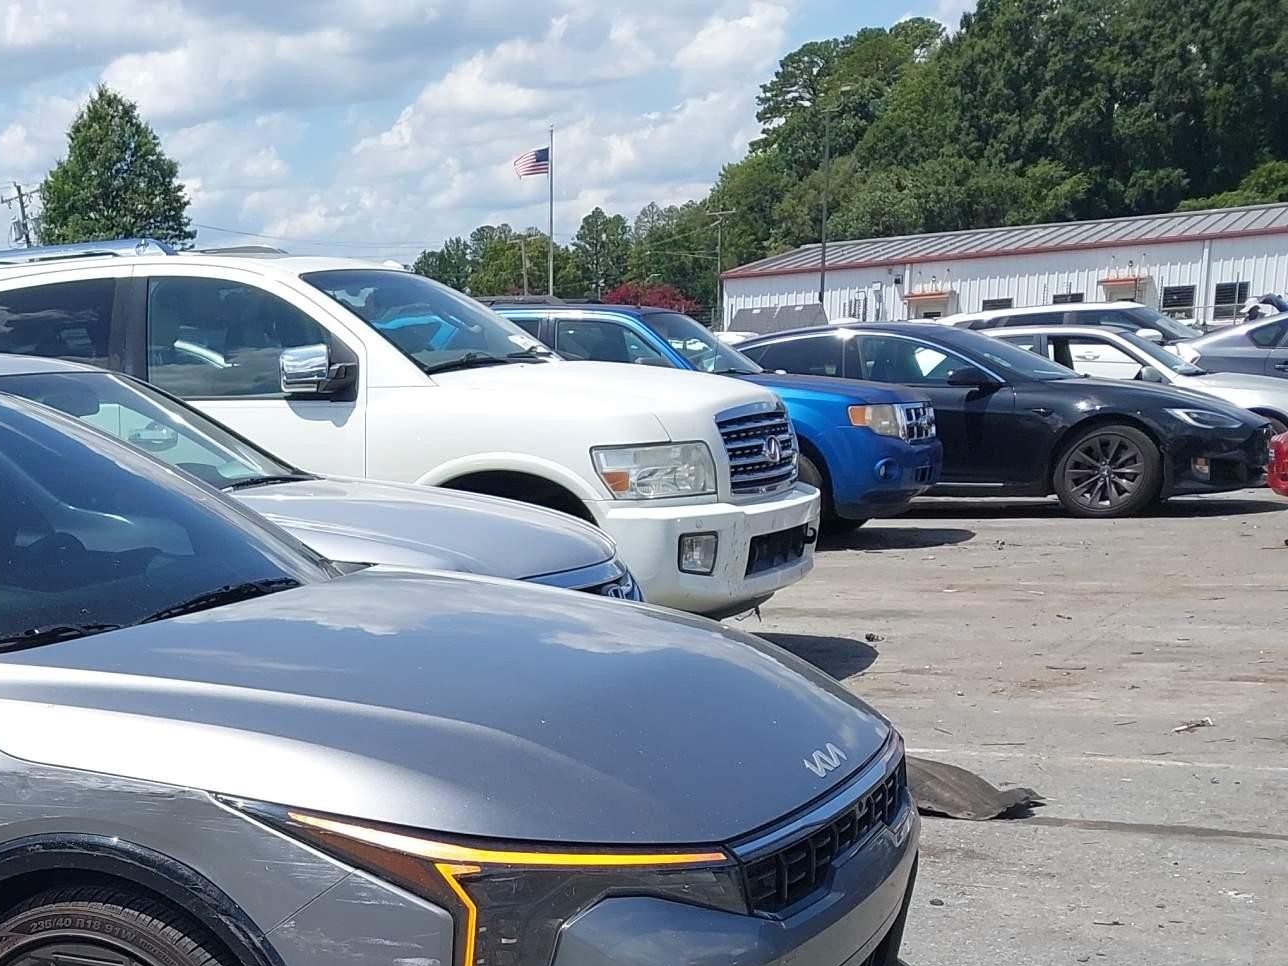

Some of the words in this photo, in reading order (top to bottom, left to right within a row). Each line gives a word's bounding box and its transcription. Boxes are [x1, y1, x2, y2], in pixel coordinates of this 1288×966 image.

[803, 742, 848, 778] KIA
[29, 917, 72, 934] 235/40
[75, 918, 102, 932] R18
[103, 922, 136, 943] 91W
